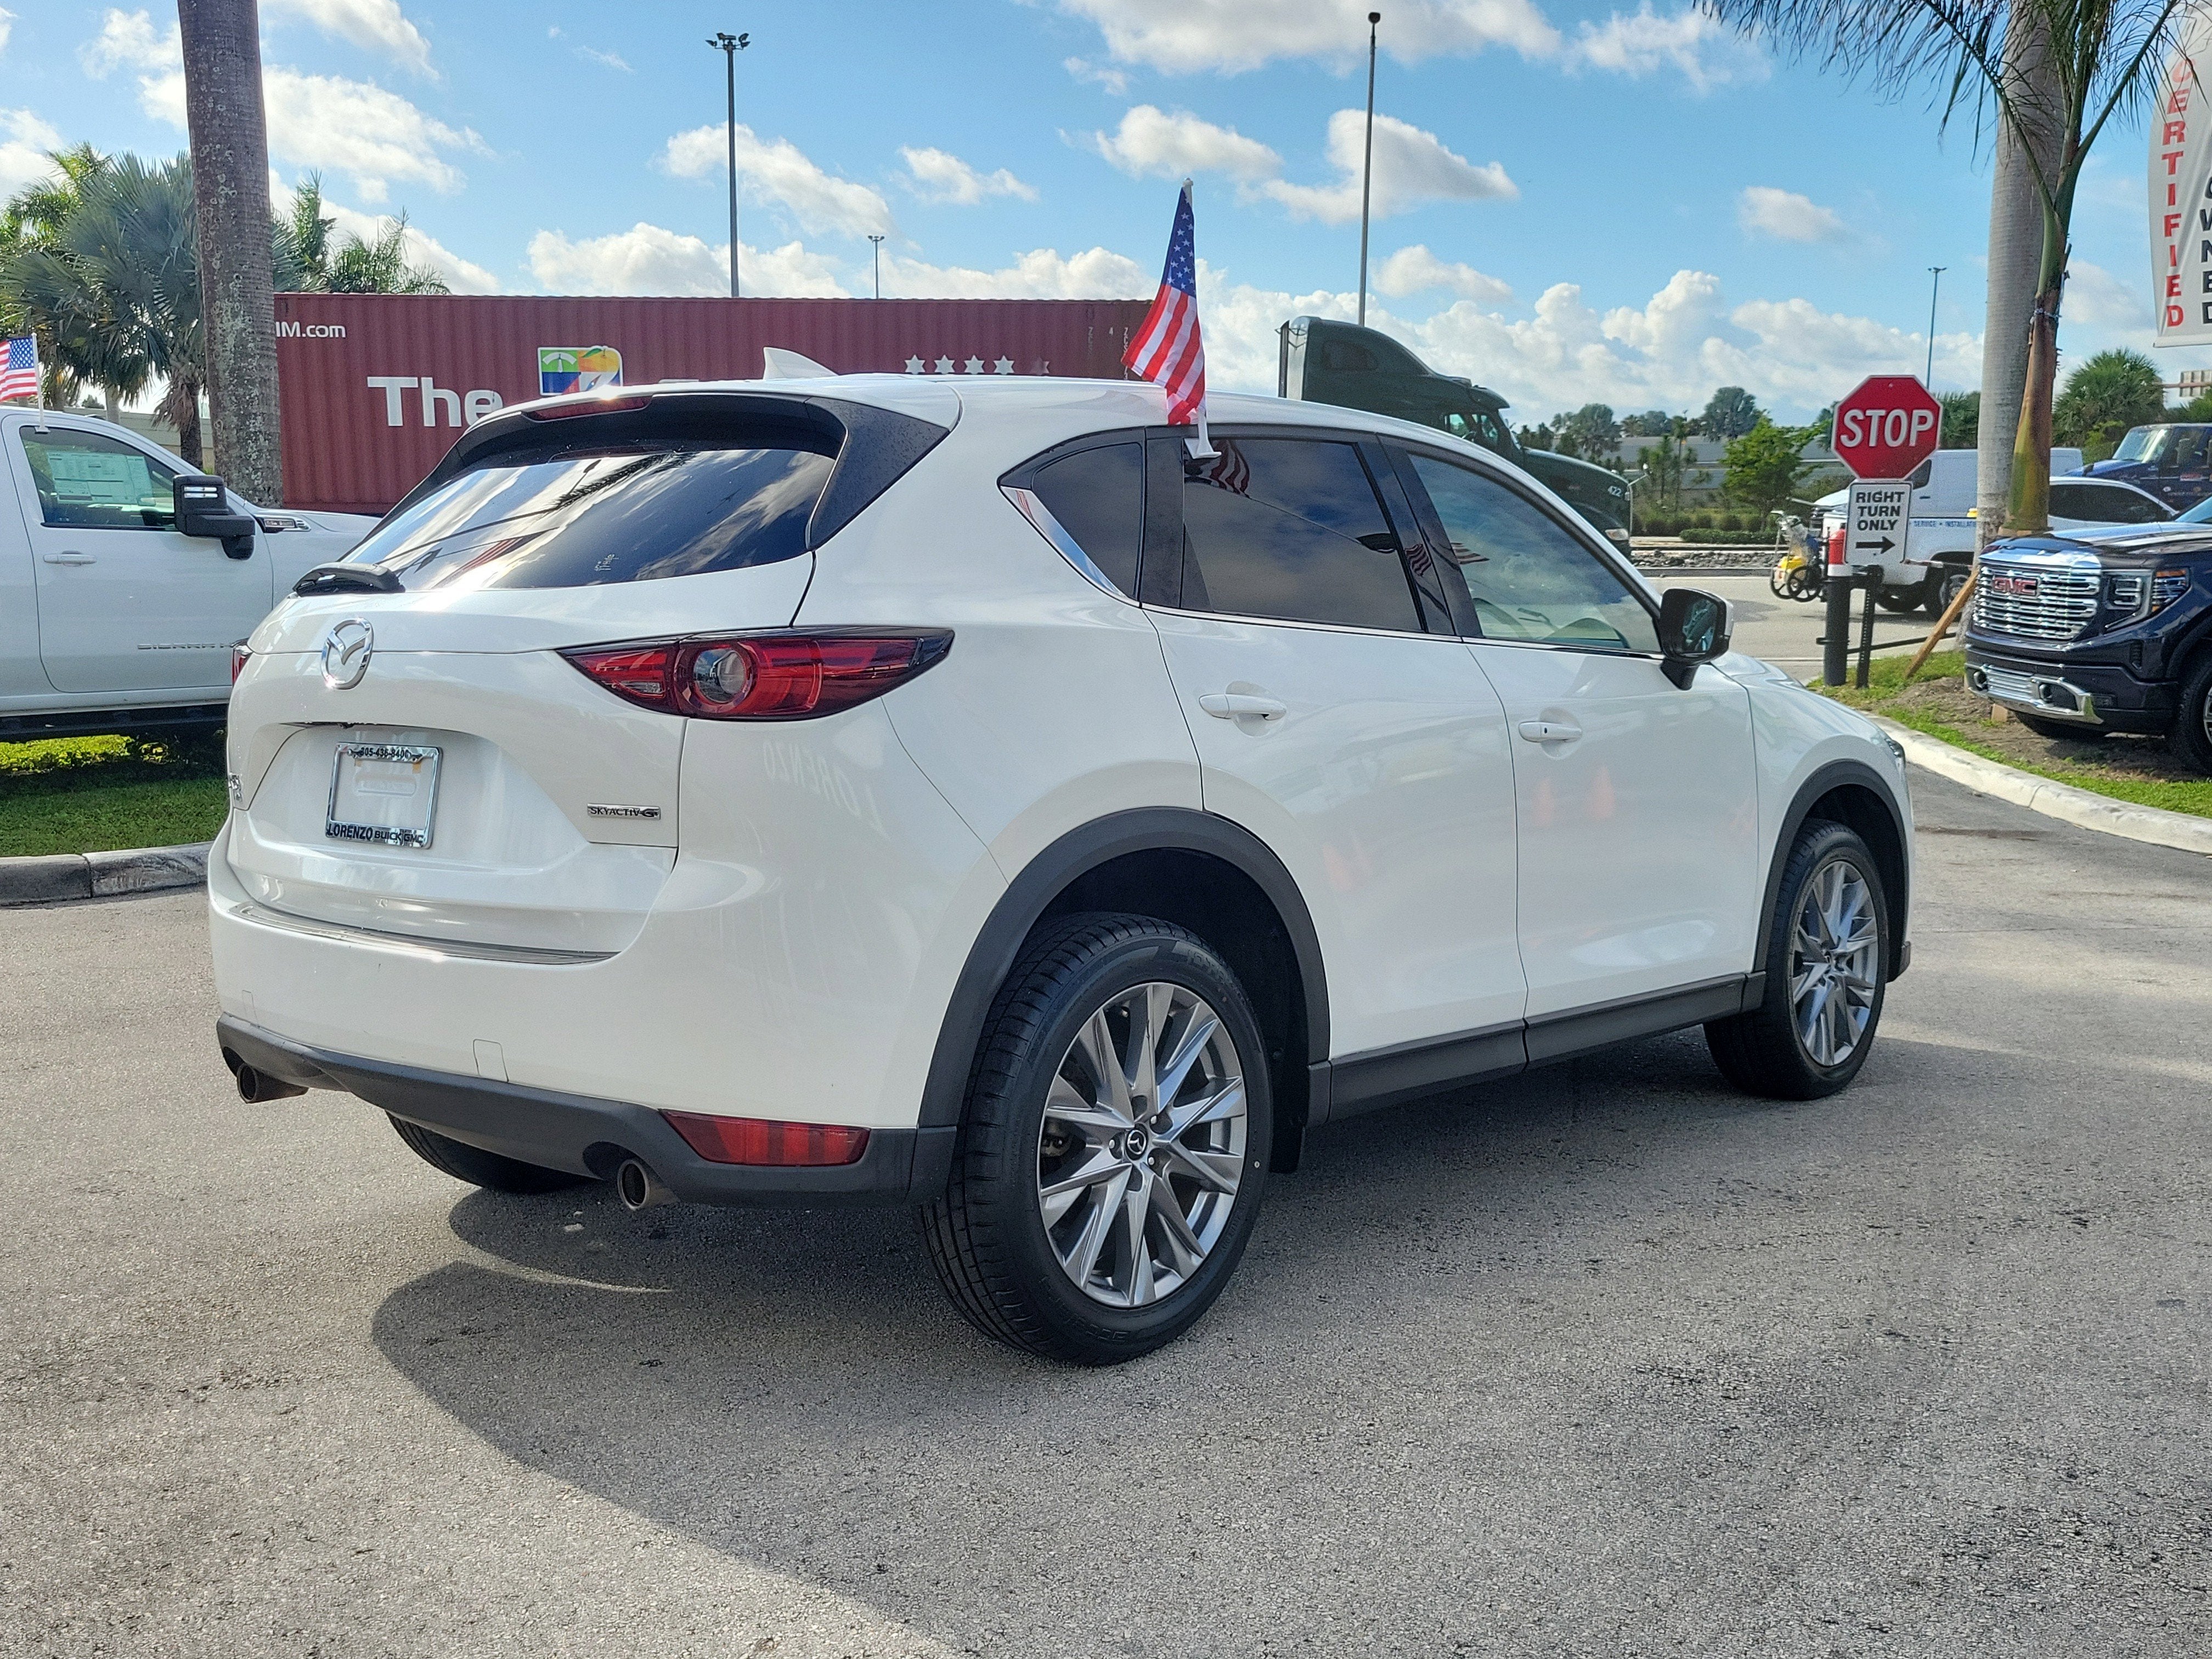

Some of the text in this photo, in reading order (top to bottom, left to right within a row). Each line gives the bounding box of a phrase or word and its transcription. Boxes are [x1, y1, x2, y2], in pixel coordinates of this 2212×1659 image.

[2160, 58, 2196, 328] CERTIFIED
[274, 321, 346, 338] IM.com
[367, 376, 504, 427] The
[1839, 409, 1934, 448] STOP
[1607, 486, 1622, 497] 422
[1856, 490, 1905, 503] RIGHT
[1857, 506, 1900, 517] TURN
[1858, 520, 1898, 531] ONLY
[1993, 577, 2037, 596] GMC
[326, 823, 373, 840] LORENZO
